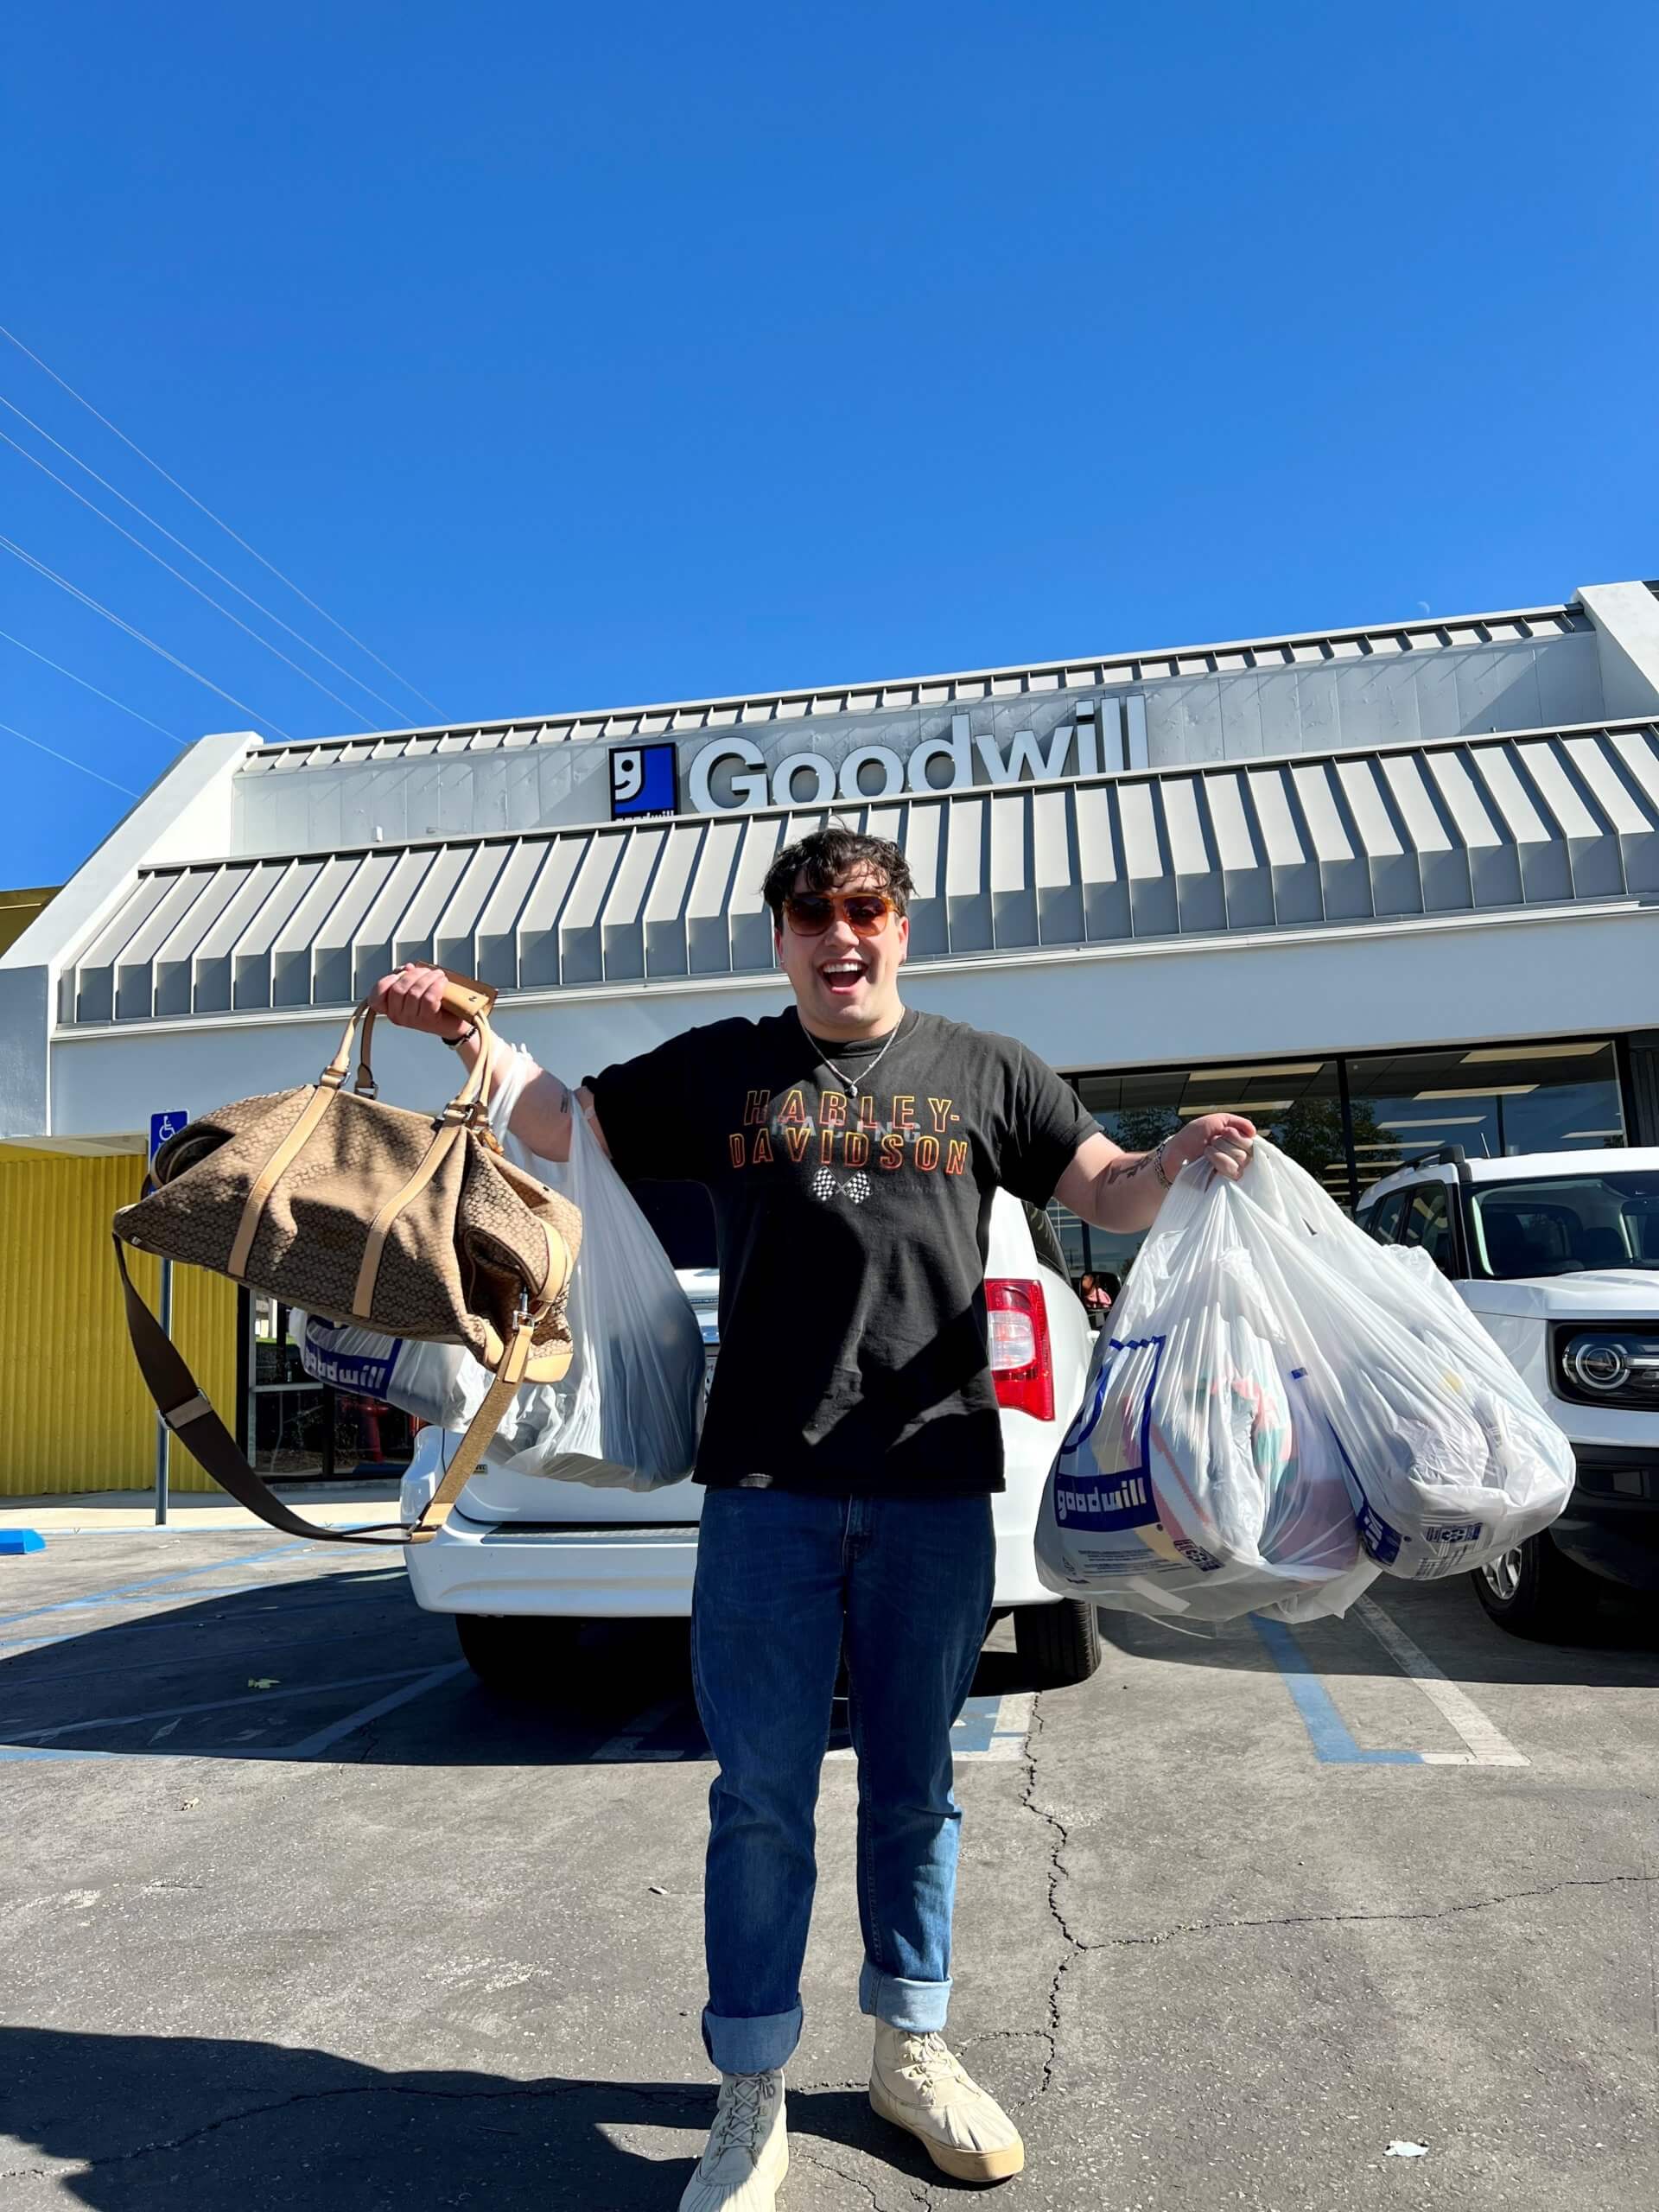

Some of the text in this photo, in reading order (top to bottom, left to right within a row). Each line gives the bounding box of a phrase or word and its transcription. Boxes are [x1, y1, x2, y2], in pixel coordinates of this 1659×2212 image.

[690, 694, 1149, 813] Goodwill
[744, 1090, 960, 1132] HARLEY-
[729, 1127, 968, 1175] DAVIDSON
[1057, 1478, 1147, 1520] goodwill
